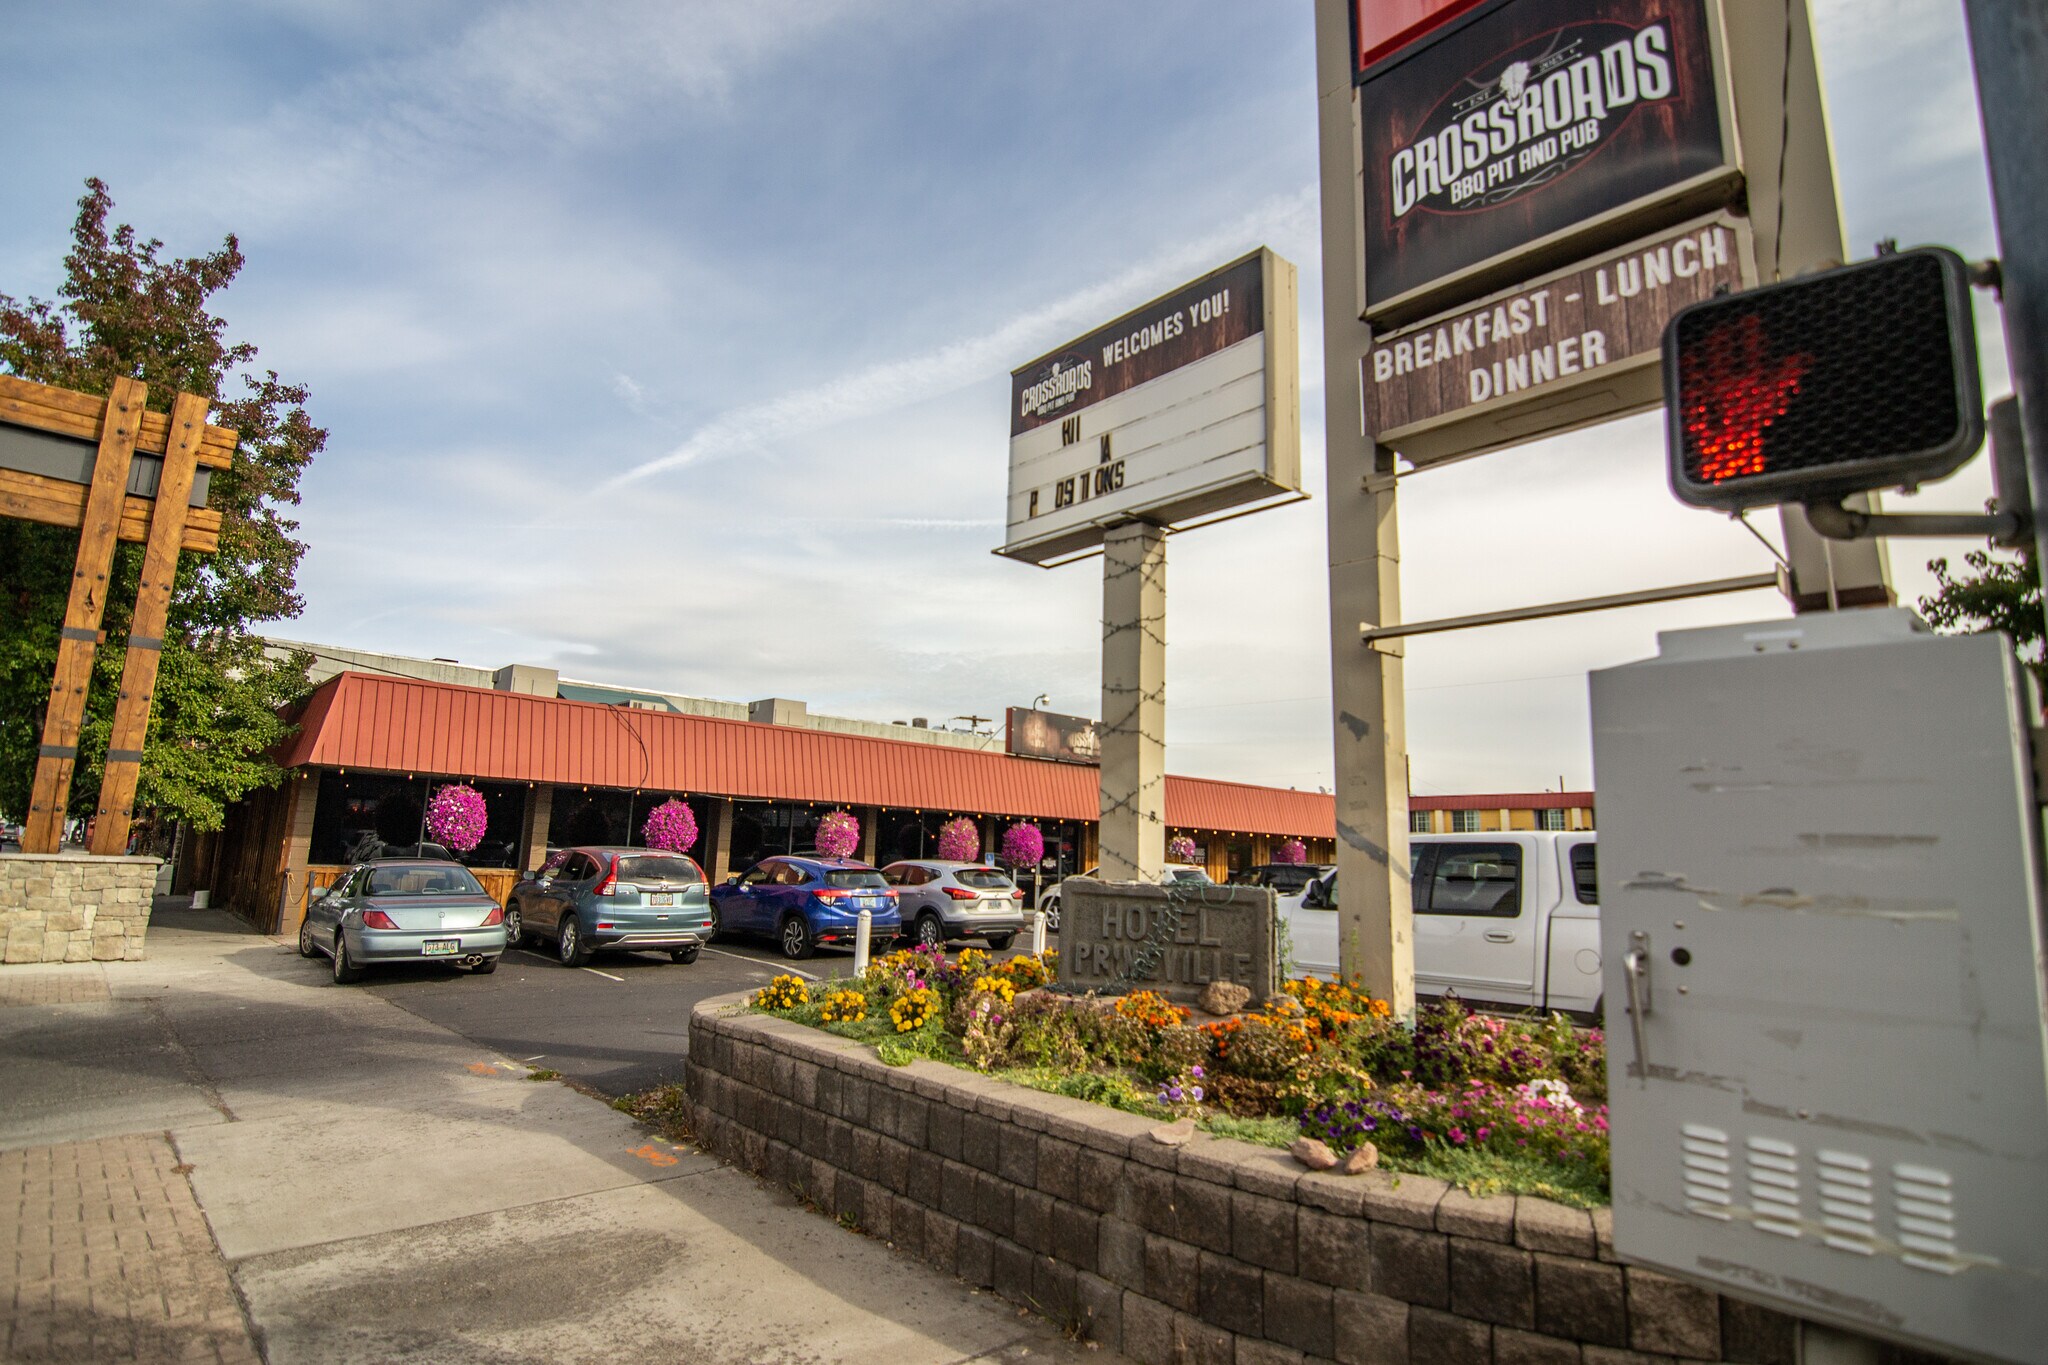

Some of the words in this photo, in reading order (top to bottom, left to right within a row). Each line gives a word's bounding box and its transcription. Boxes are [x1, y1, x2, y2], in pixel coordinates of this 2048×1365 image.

[1391, 24, 1673, 218] CROSSROADS
[1451, 170, 1486, 205] BBQ
[1487, 154, 1515, 188] PIT
[1518, 136, 1558, 174] AND
[1560, 118, 1600, 155] PUB
[1102, 312, 1184, 368] WELCOMES
[1189, 288, 1230, 328] YOU!
[1373, 289, 1552, 384] BREAKFAST
[1595, 226, 1729, 306] LUNCH
[1021, 359, 1092, 418] CROSSROADS
[1468, 329, 1608, 404] DINNER
[1101, 900, 1222, 948] HOTEL
